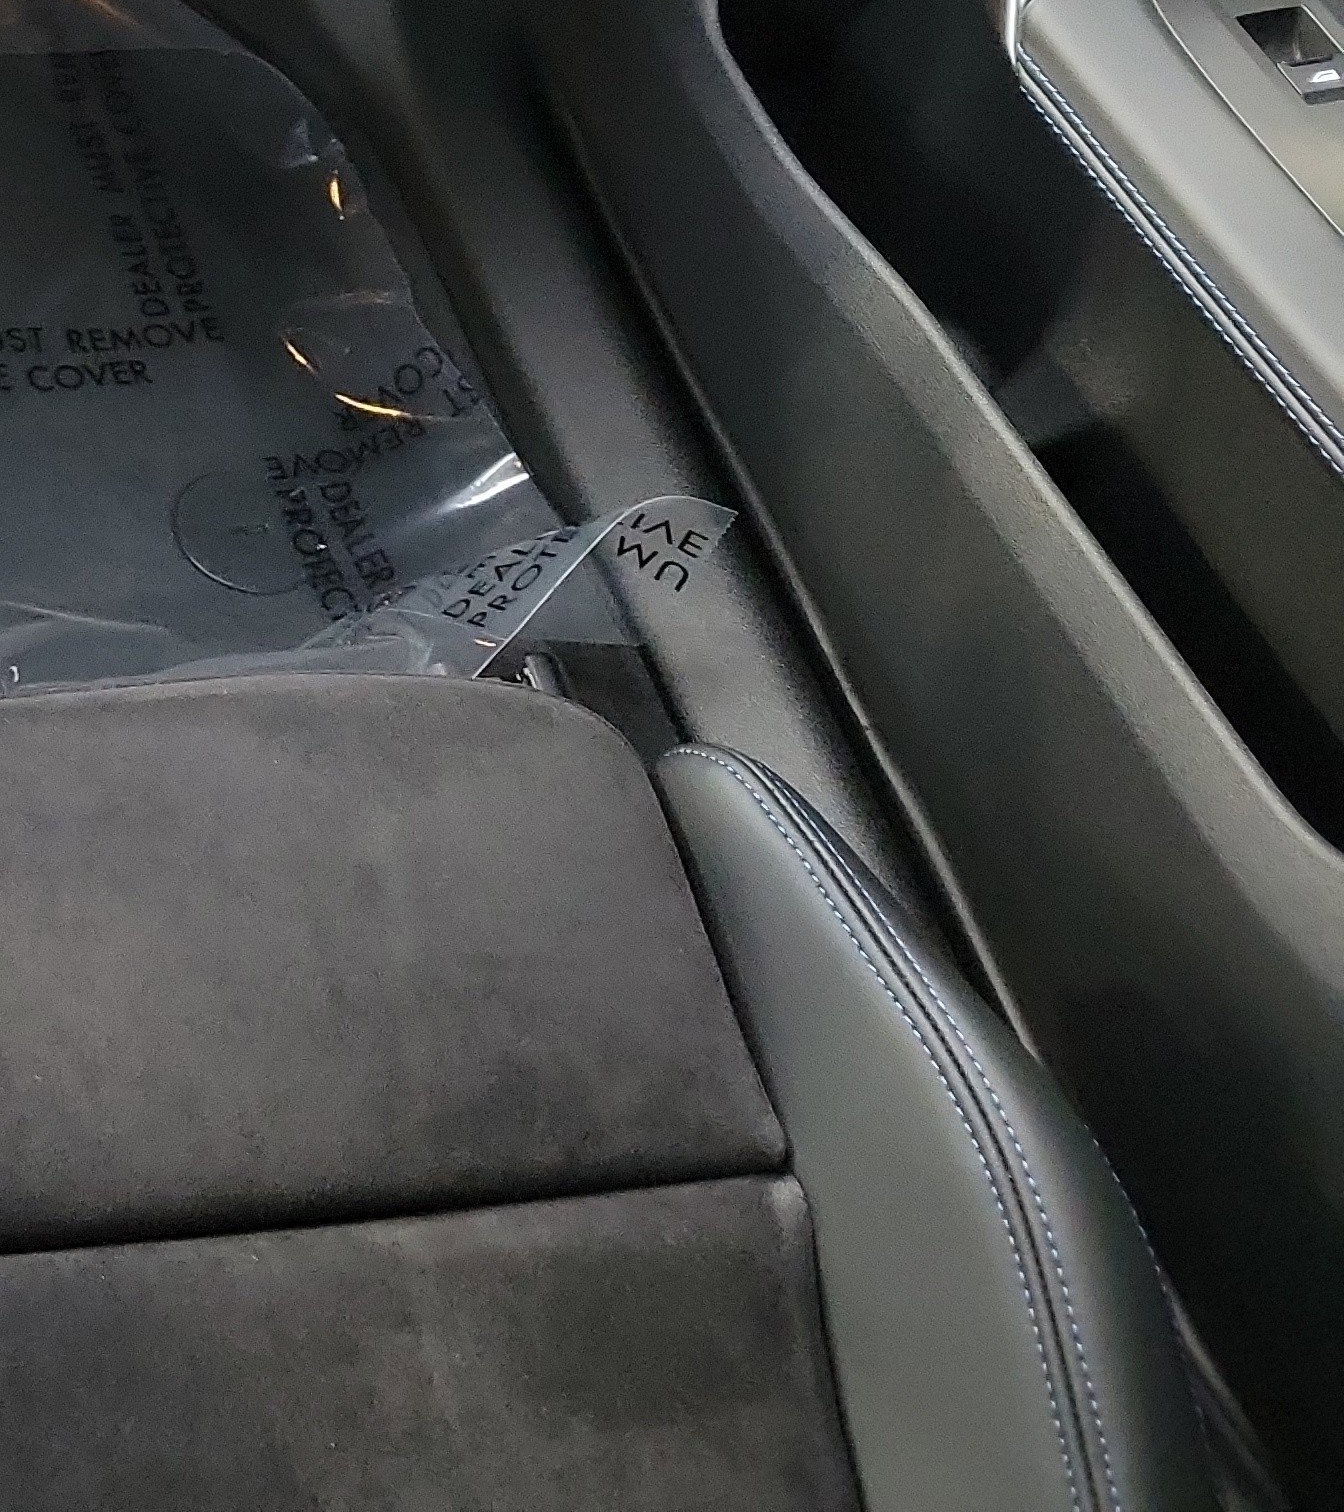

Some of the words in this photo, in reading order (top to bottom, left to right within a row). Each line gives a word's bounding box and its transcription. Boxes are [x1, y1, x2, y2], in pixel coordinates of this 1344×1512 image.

[65, 316, 225, 355] REMOVE
[26, 359, 154, 393] COVER
[263, 418, 427, 481] REMOVE
